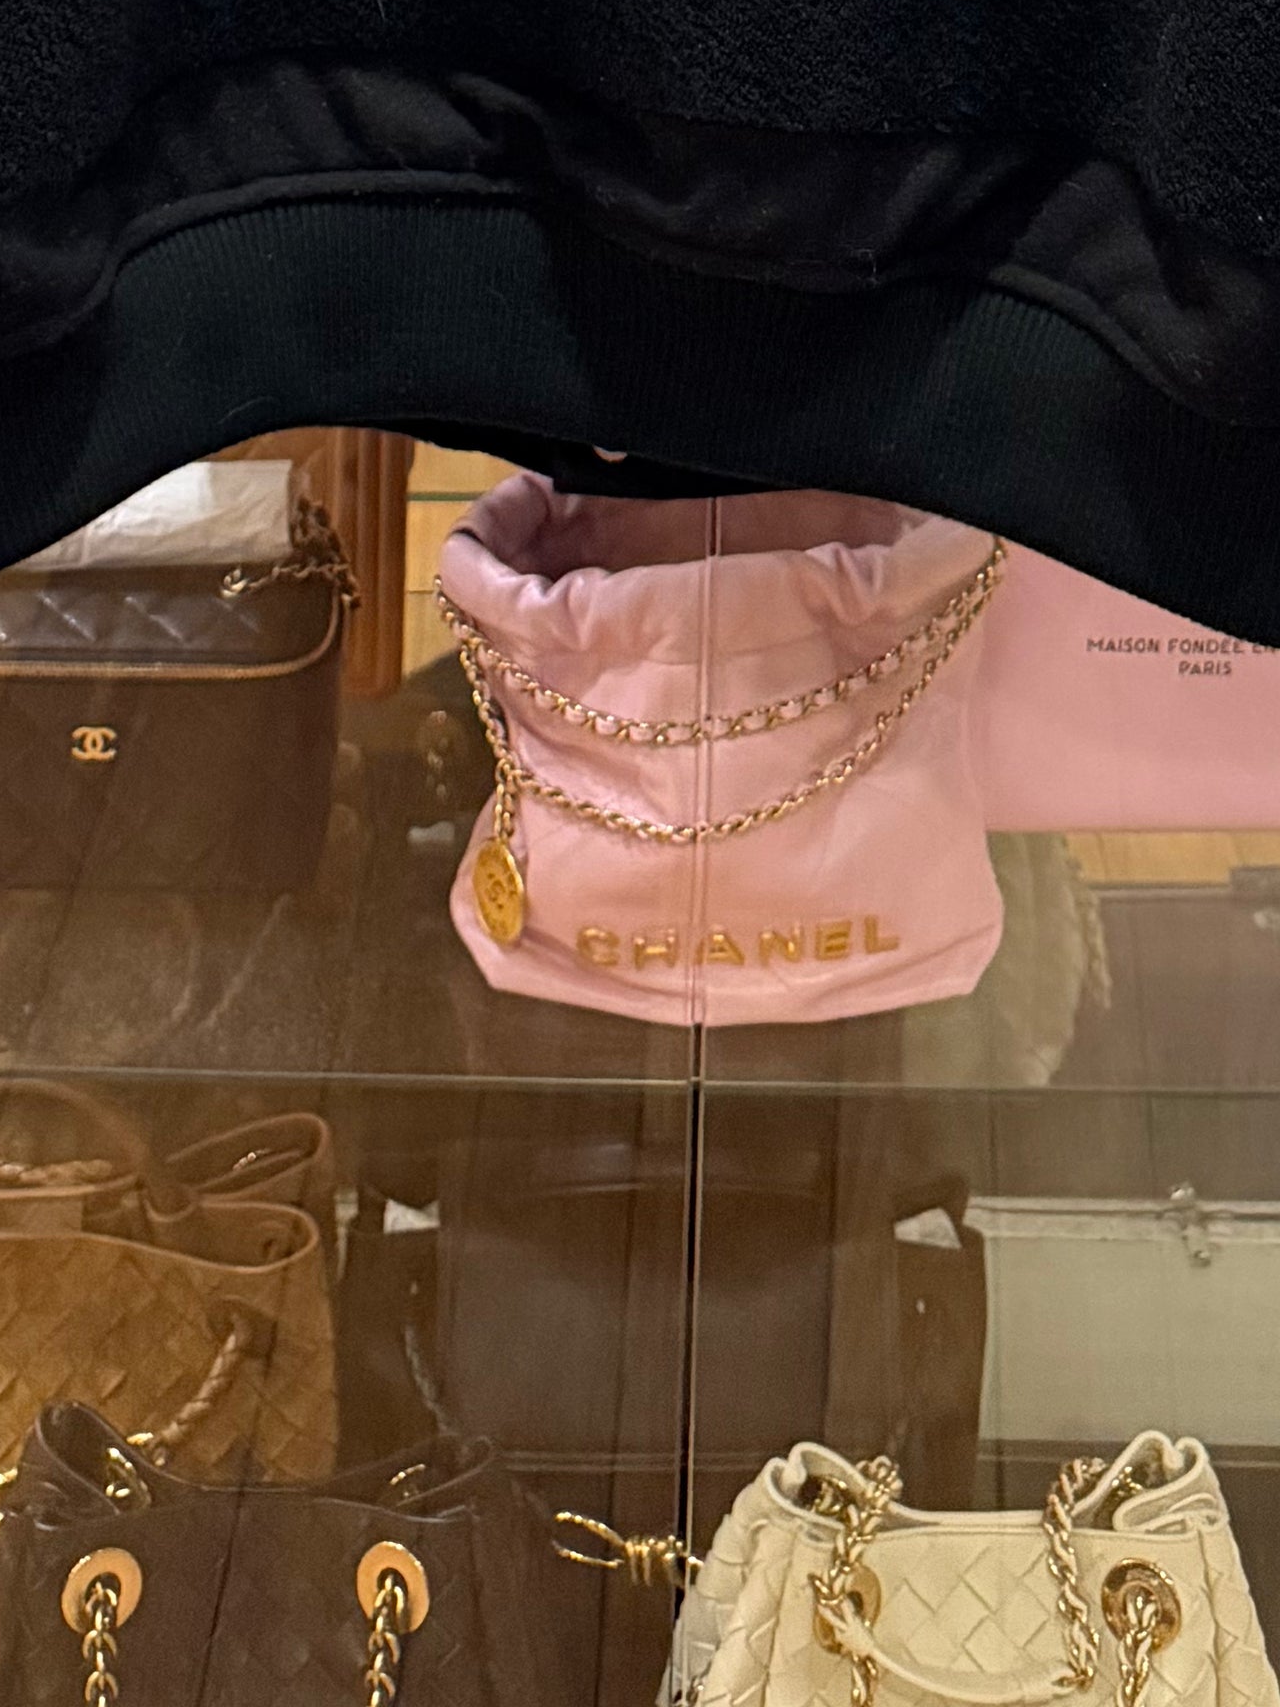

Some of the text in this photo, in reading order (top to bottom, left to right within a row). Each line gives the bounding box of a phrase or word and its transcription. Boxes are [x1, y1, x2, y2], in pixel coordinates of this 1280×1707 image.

[1086, 638, 1160, 654] MAISON
[1177, 660, 1233, 676] PARIS
[576, 914, 900, 971] CHANEL
